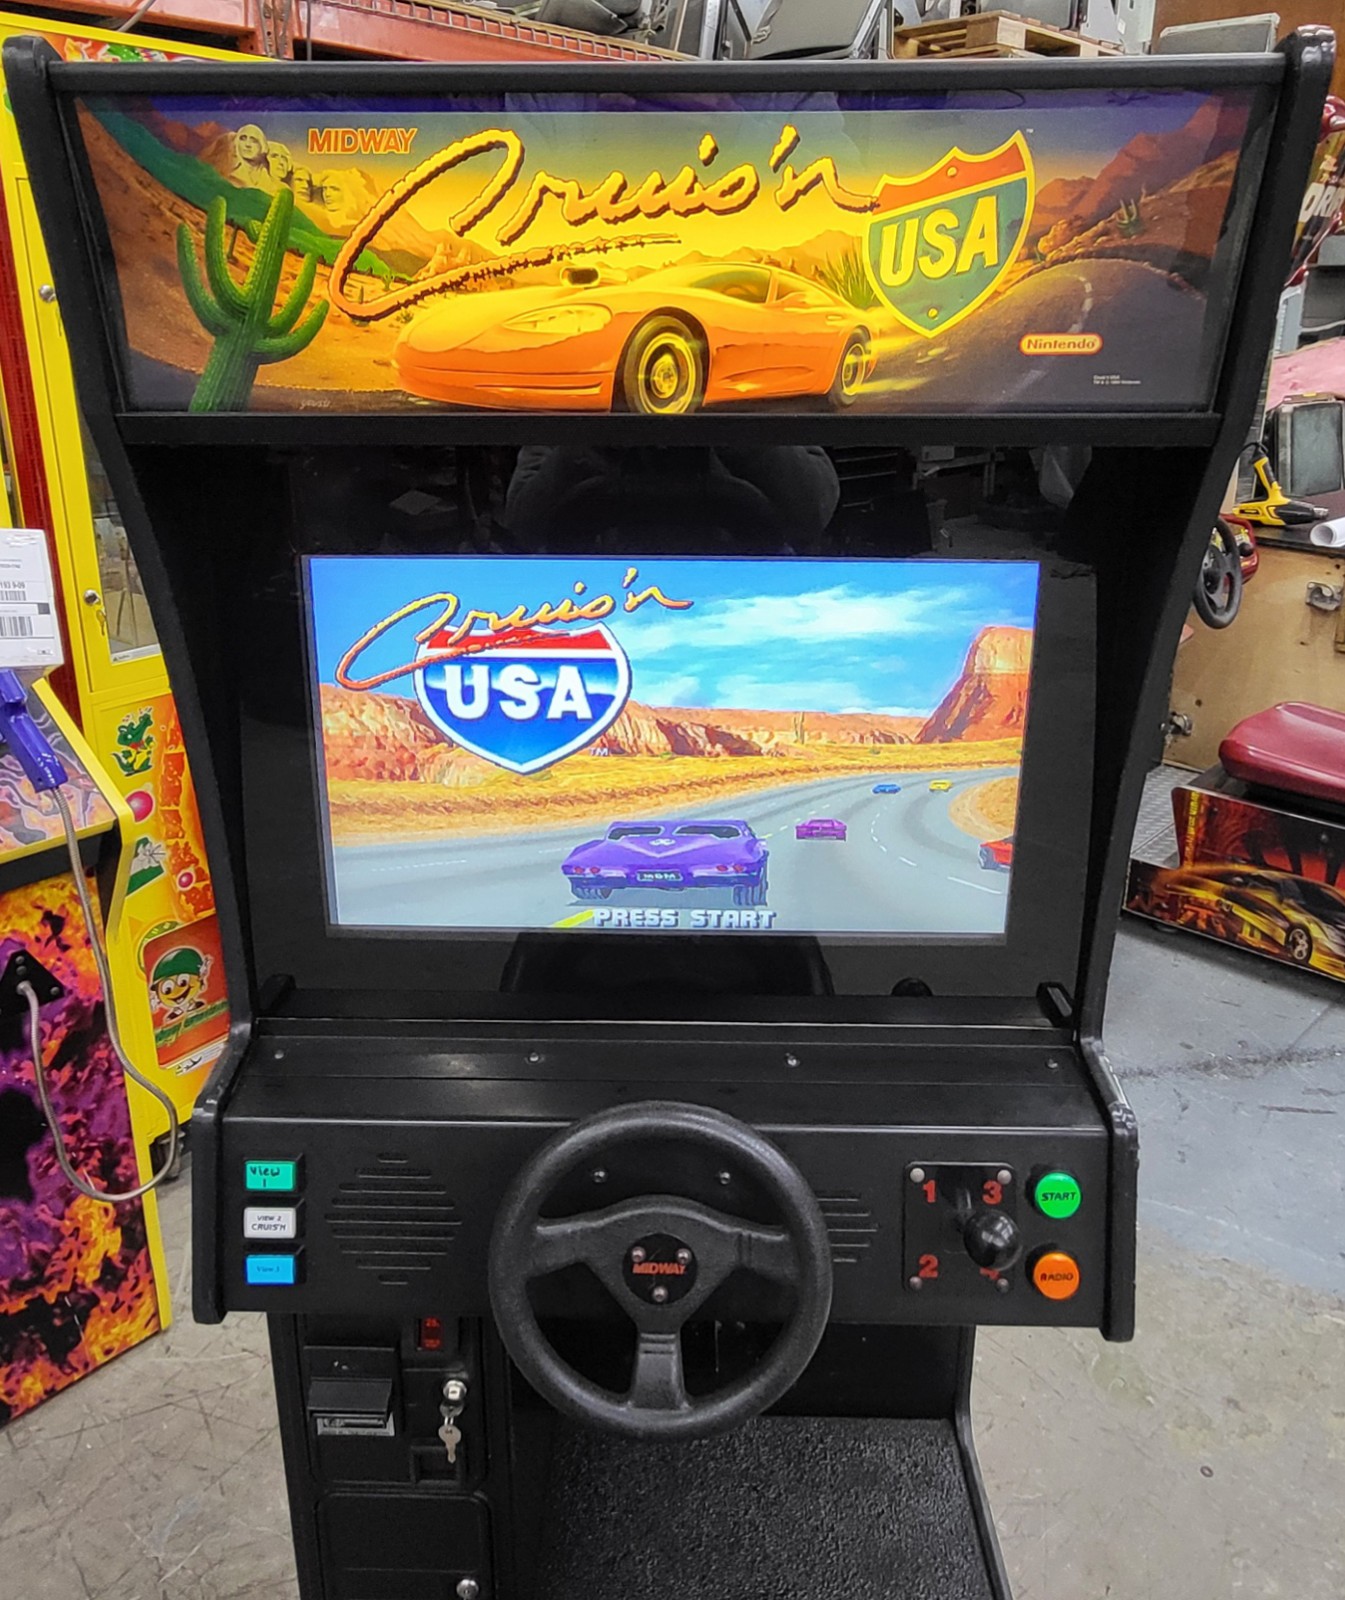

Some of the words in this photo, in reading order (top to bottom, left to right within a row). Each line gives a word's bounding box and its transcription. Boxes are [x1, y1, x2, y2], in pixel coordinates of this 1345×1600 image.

[308, 127, 418, 155] MIDWAY
[329, 124, 881, 322] Cruis'n
[879, 195, 999, 287] USA
[1026, 338, 1096, 350] Nintendo
[336, 567, 694, 691] Cruis'n
[445, 664, 593, 721] USA
[594, 908, 679, 929] PRESS
[690, 908, 777, 929] START
[922, 1179, 937, 1204] 1
[982, 1179, 1003, 1205] 3
[1040, 1191, 1077, 1203] START
[632, 1262, 687, 1275] MIDWAY
[918, 1253, 939, 1278] 2
[1040, 1272, 1074, 1283] RADIO
